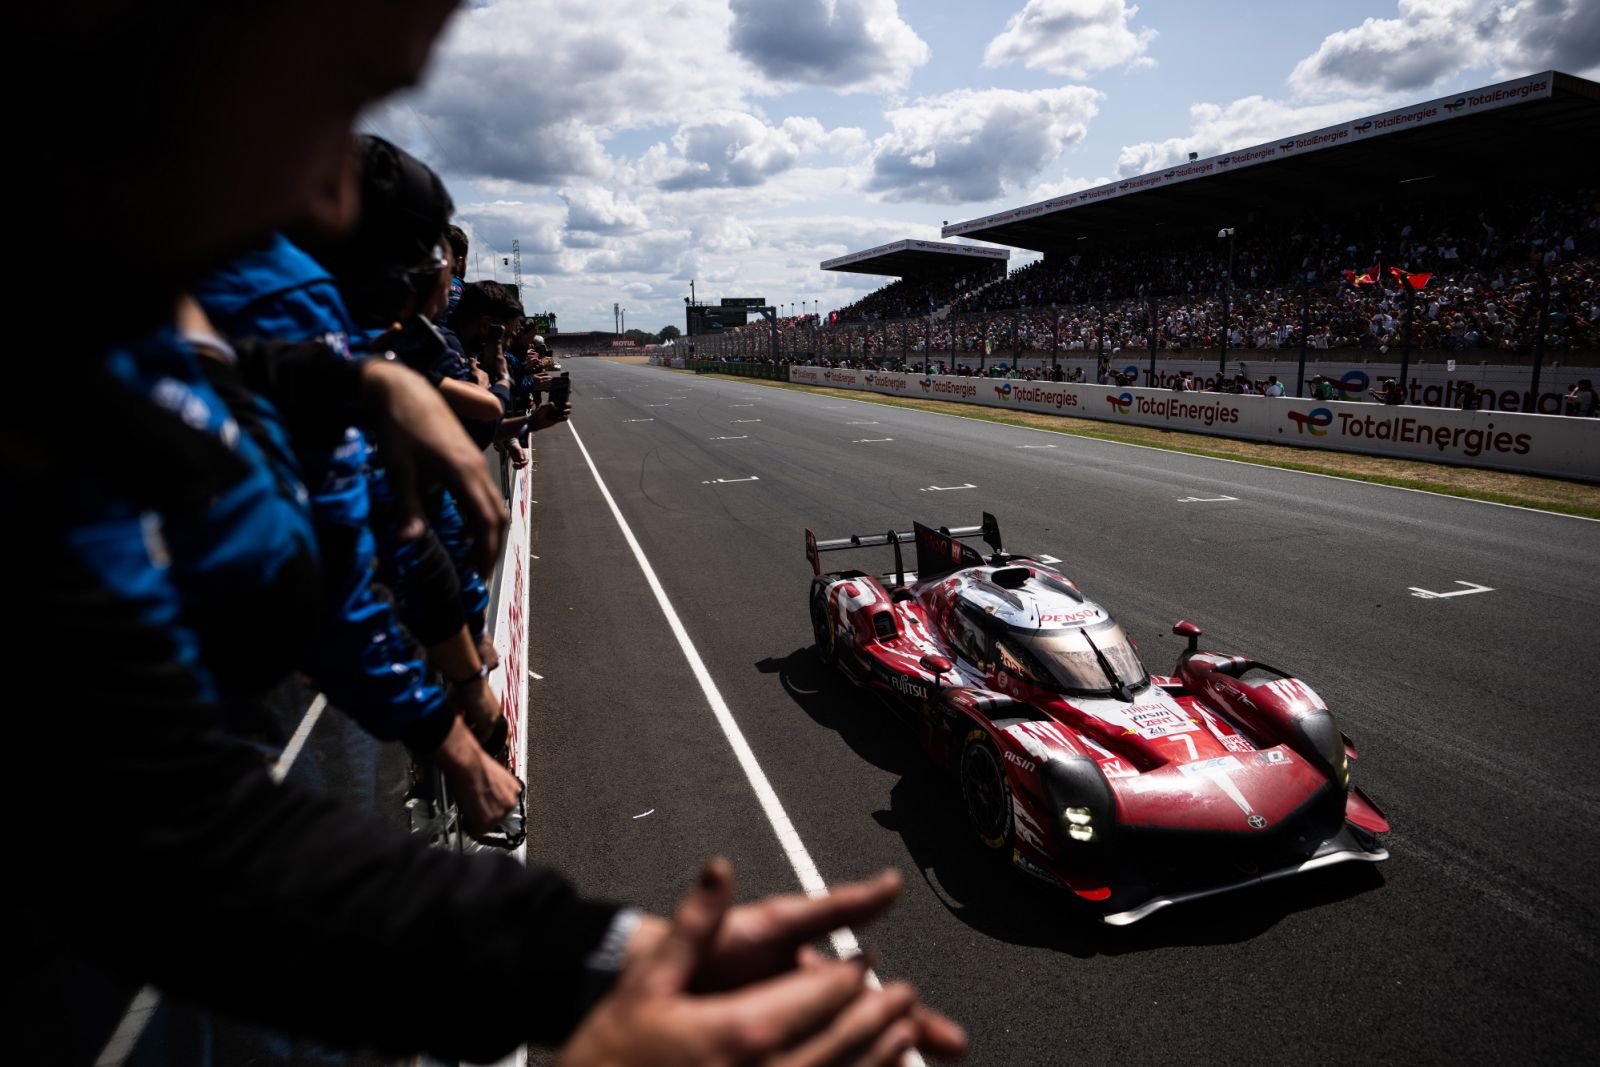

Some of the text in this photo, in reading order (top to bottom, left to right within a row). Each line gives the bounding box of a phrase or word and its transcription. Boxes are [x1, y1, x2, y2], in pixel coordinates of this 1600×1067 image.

[1467, 80, 1547, 107] TotalEnergies
[1373, 106, 1437, 130] TotalEnergies
[1295, 128, 1348, 149] TotalEnergies
[1231, 147, 1275, 164] TotalEnergies
[875, 375, 906, 390] TotalEnergies
[932, 380, 976, 399] TotalEnergies
[1013, 386, 1078, 408] TotalEnergies
[1135, 395, 1239, 426] TotalEnergies
[1338, 412, 1532, 457] TotalEnergies
[1040, 609, 1094, 622] DENSO
[891, 675, 928, 700] FUJITSU
[1143, 717, 1174, 726] ZENT
[1168, 733, 1200, 760] 7
[1004, 750, 1036, 773] AISIN
